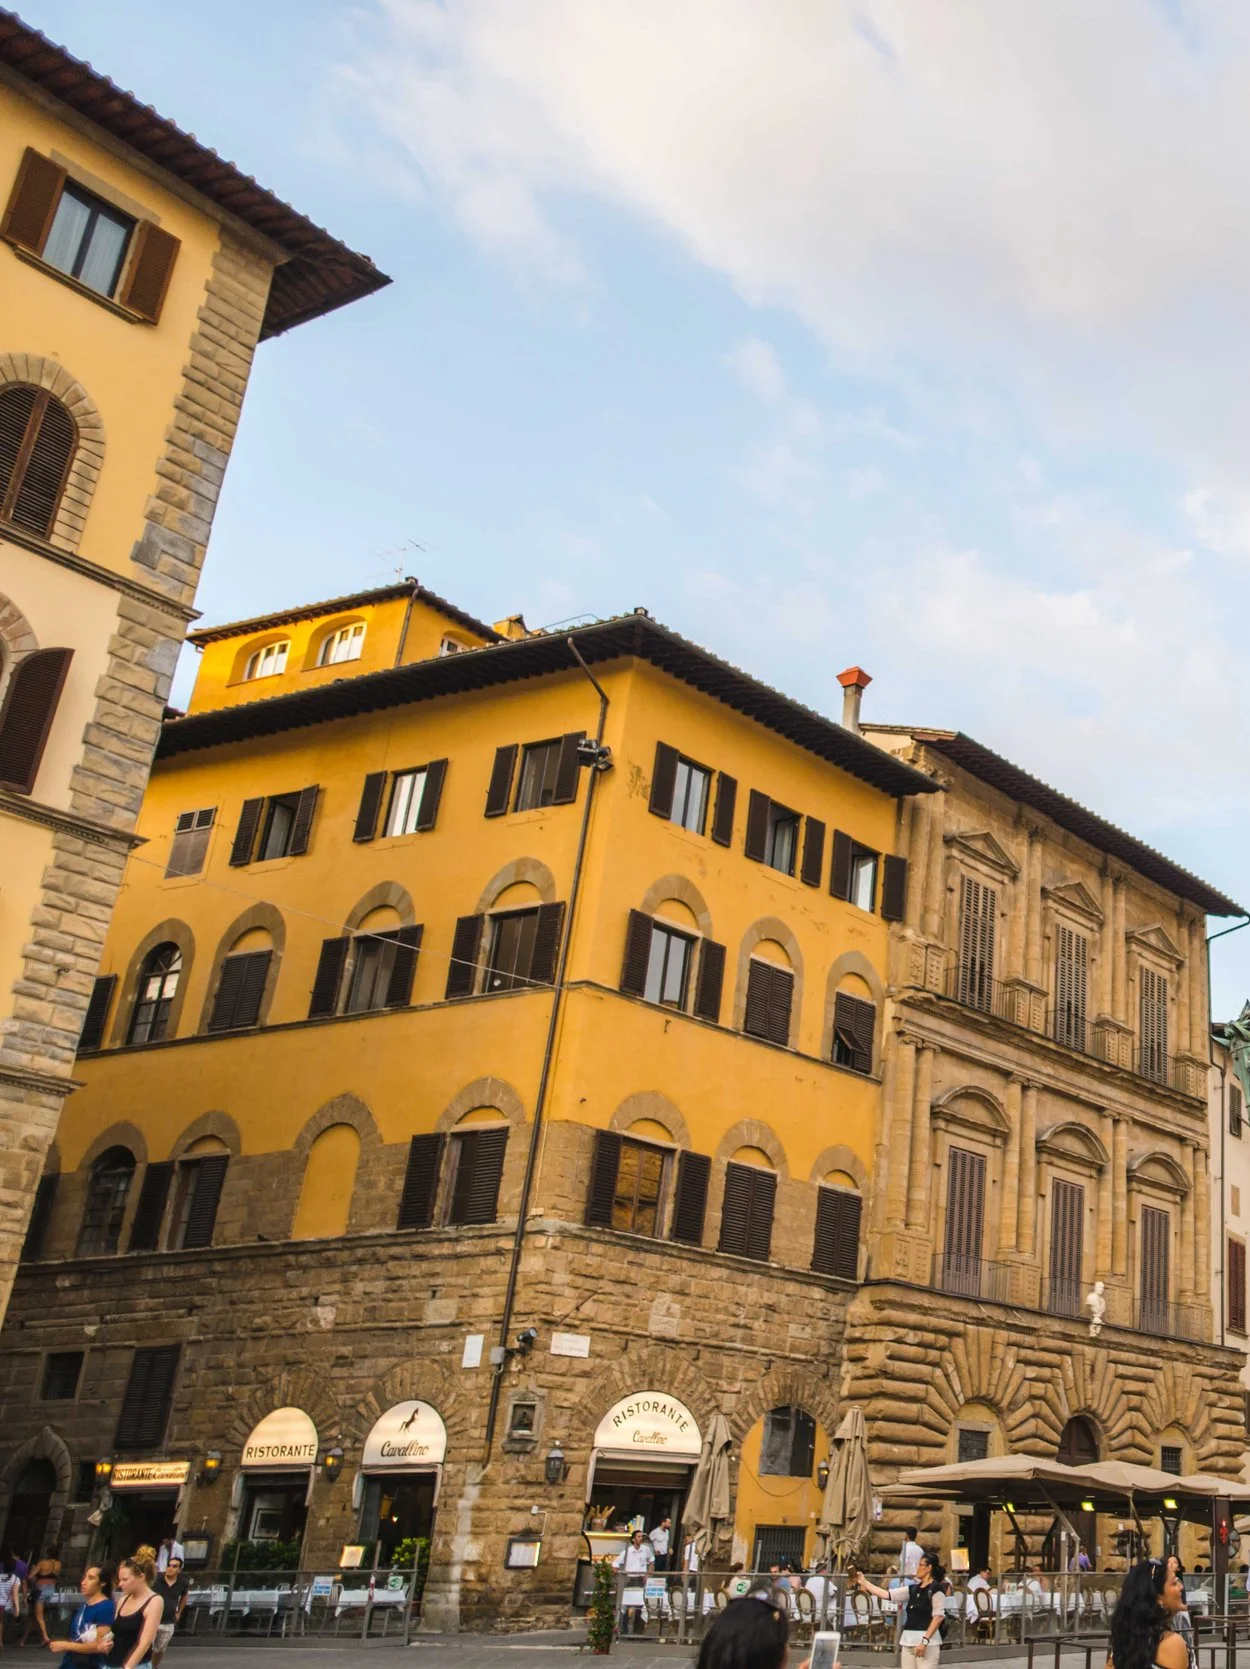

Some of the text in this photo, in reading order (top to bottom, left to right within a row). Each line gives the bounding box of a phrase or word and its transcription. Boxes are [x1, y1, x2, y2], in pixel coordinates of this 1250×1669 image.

[613, 1400, 689, 1432] RISTORANTE
[246, 1444, 315, 1458] RISTORANTE
[380, 1439, 430, 1457] Cavallino
[112, 1467, 152, 1480] RISTORANTE
